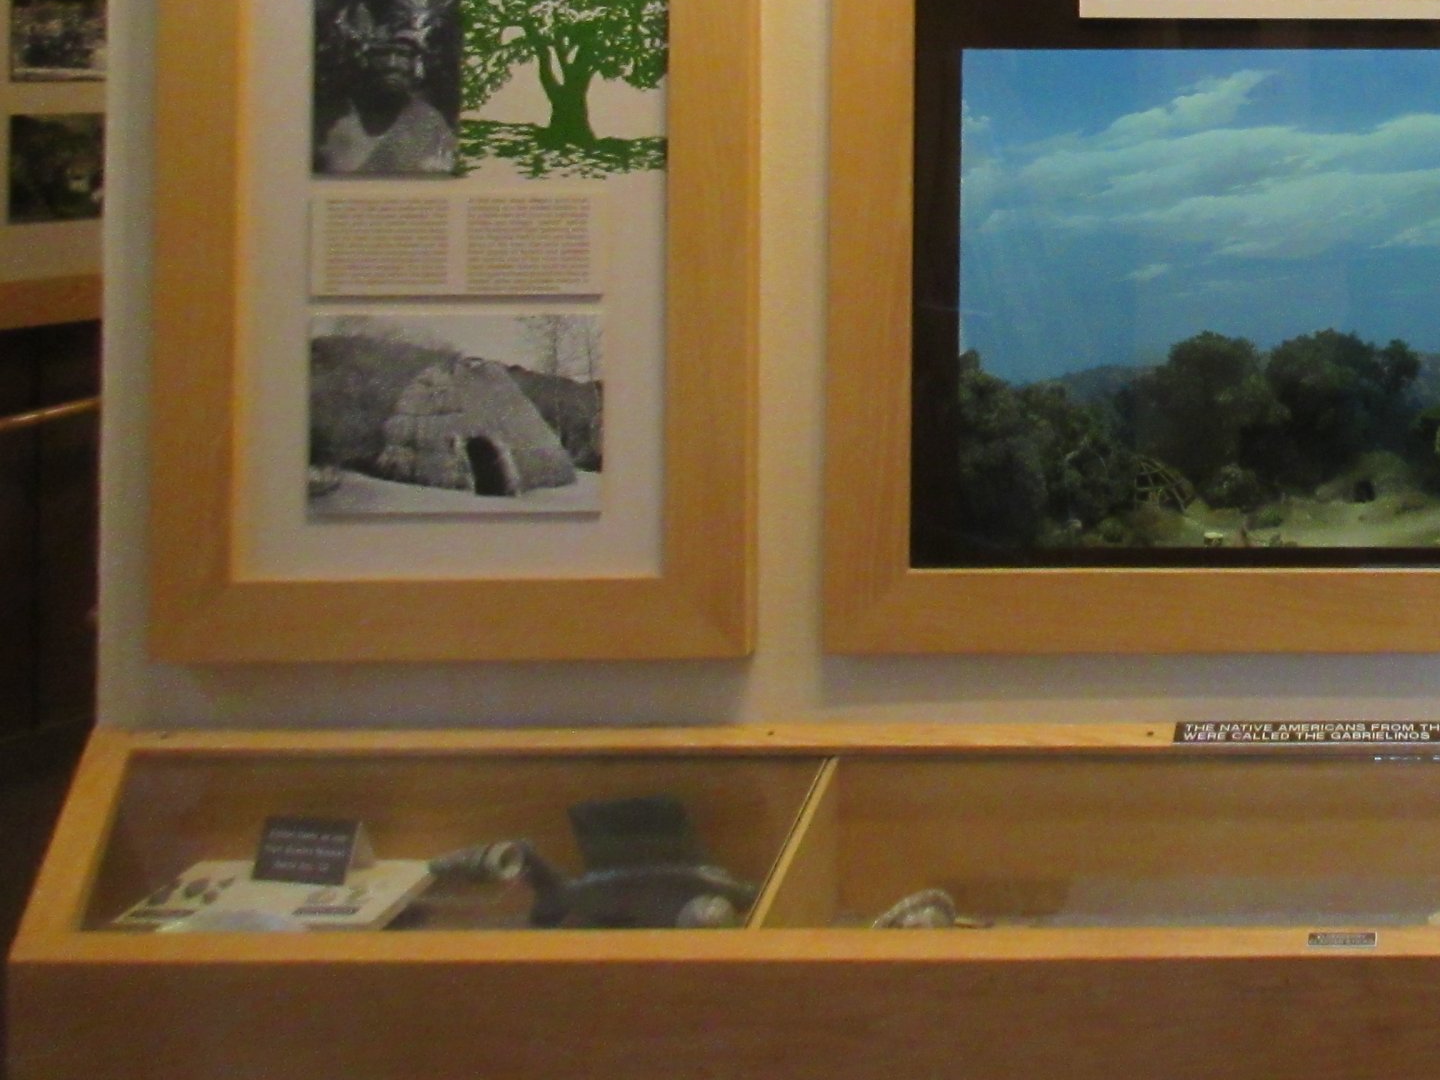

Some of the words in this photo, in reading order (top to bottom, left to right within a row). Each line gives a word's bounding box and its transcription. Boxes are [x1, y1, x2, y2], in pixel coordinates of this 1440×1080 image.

[1185, 723, 1214, 732] THE
[1219, 723, 1273, 732] NATIVE
[1278, 723, 1366, 732] AMERICANS
[1371, 723, 1414, 732] FROM
[1184, 731, 1226, 741] WERE
[1231, 731, 1290, 741] CALLED
[1296, 731, 1325, 741] THE
[1330, 731, 1431, 741] GABRIELINOS
